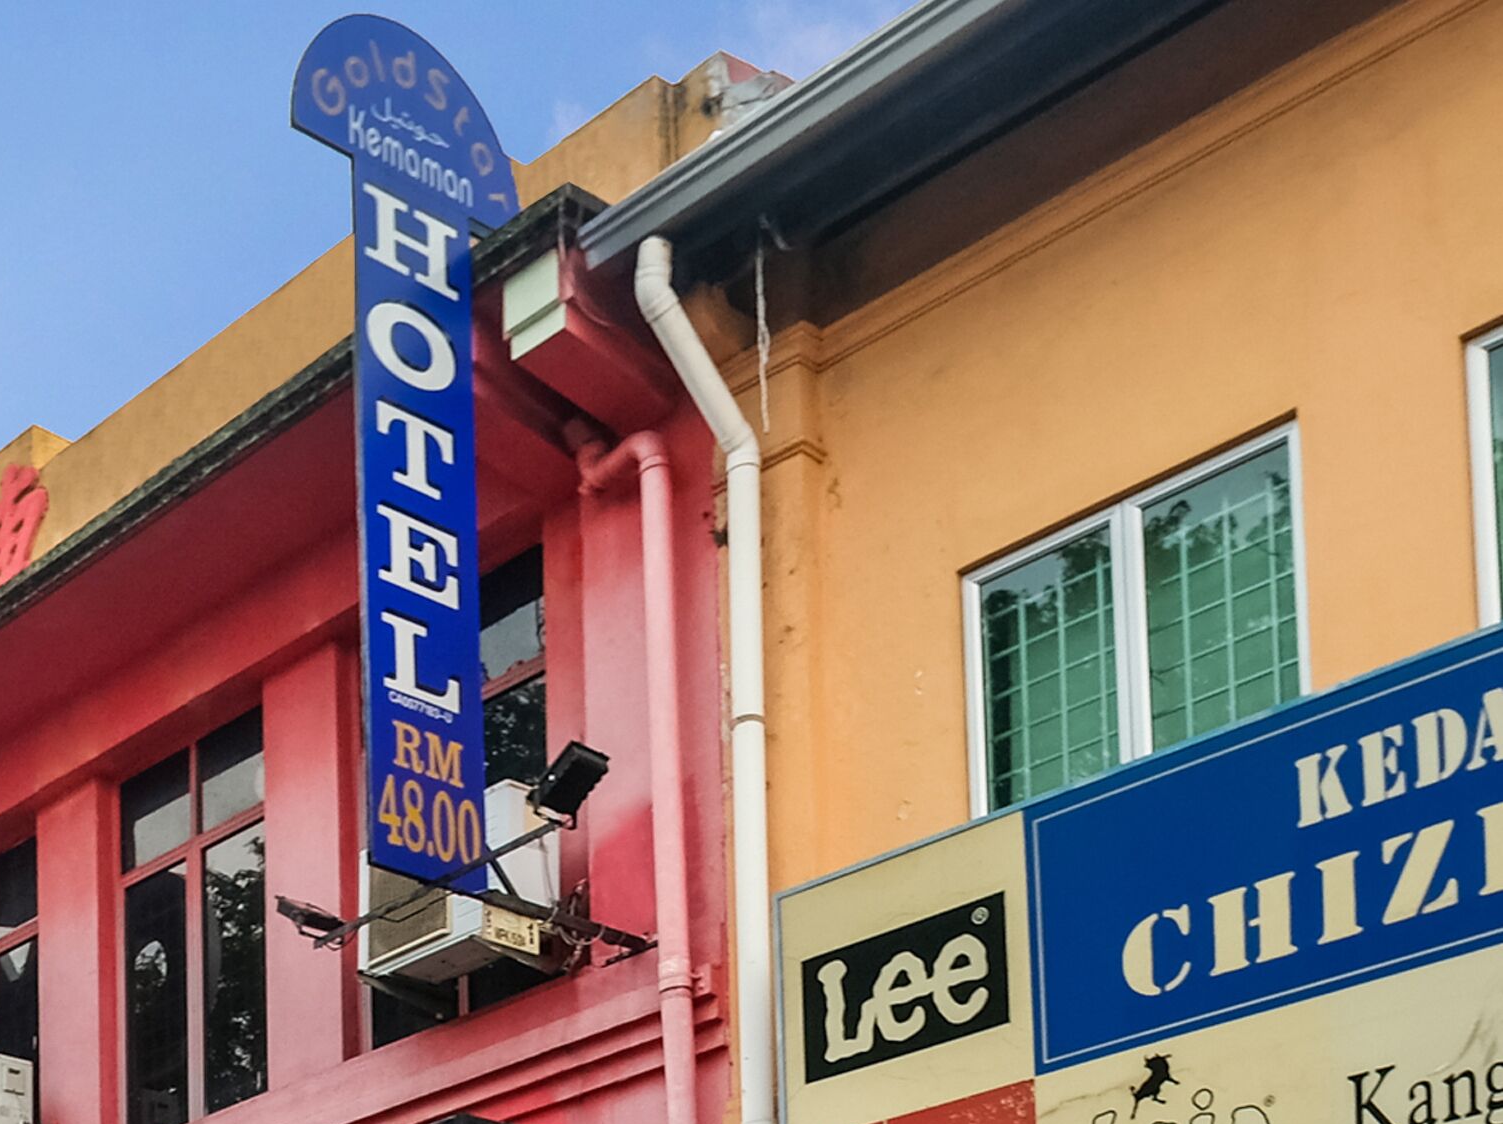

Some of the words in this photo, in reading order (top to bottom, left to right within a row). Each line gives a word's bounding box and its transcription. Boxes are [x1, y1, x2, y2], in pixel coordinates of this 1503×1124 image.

[348, 103, 474, 208] Kemaman
[362, 182, 461, 715] HOTEL
[392, 719, 465, 789] RM
[377, 772, 482, 866] 48.00
[817, 933, 989, 1063] Lee
